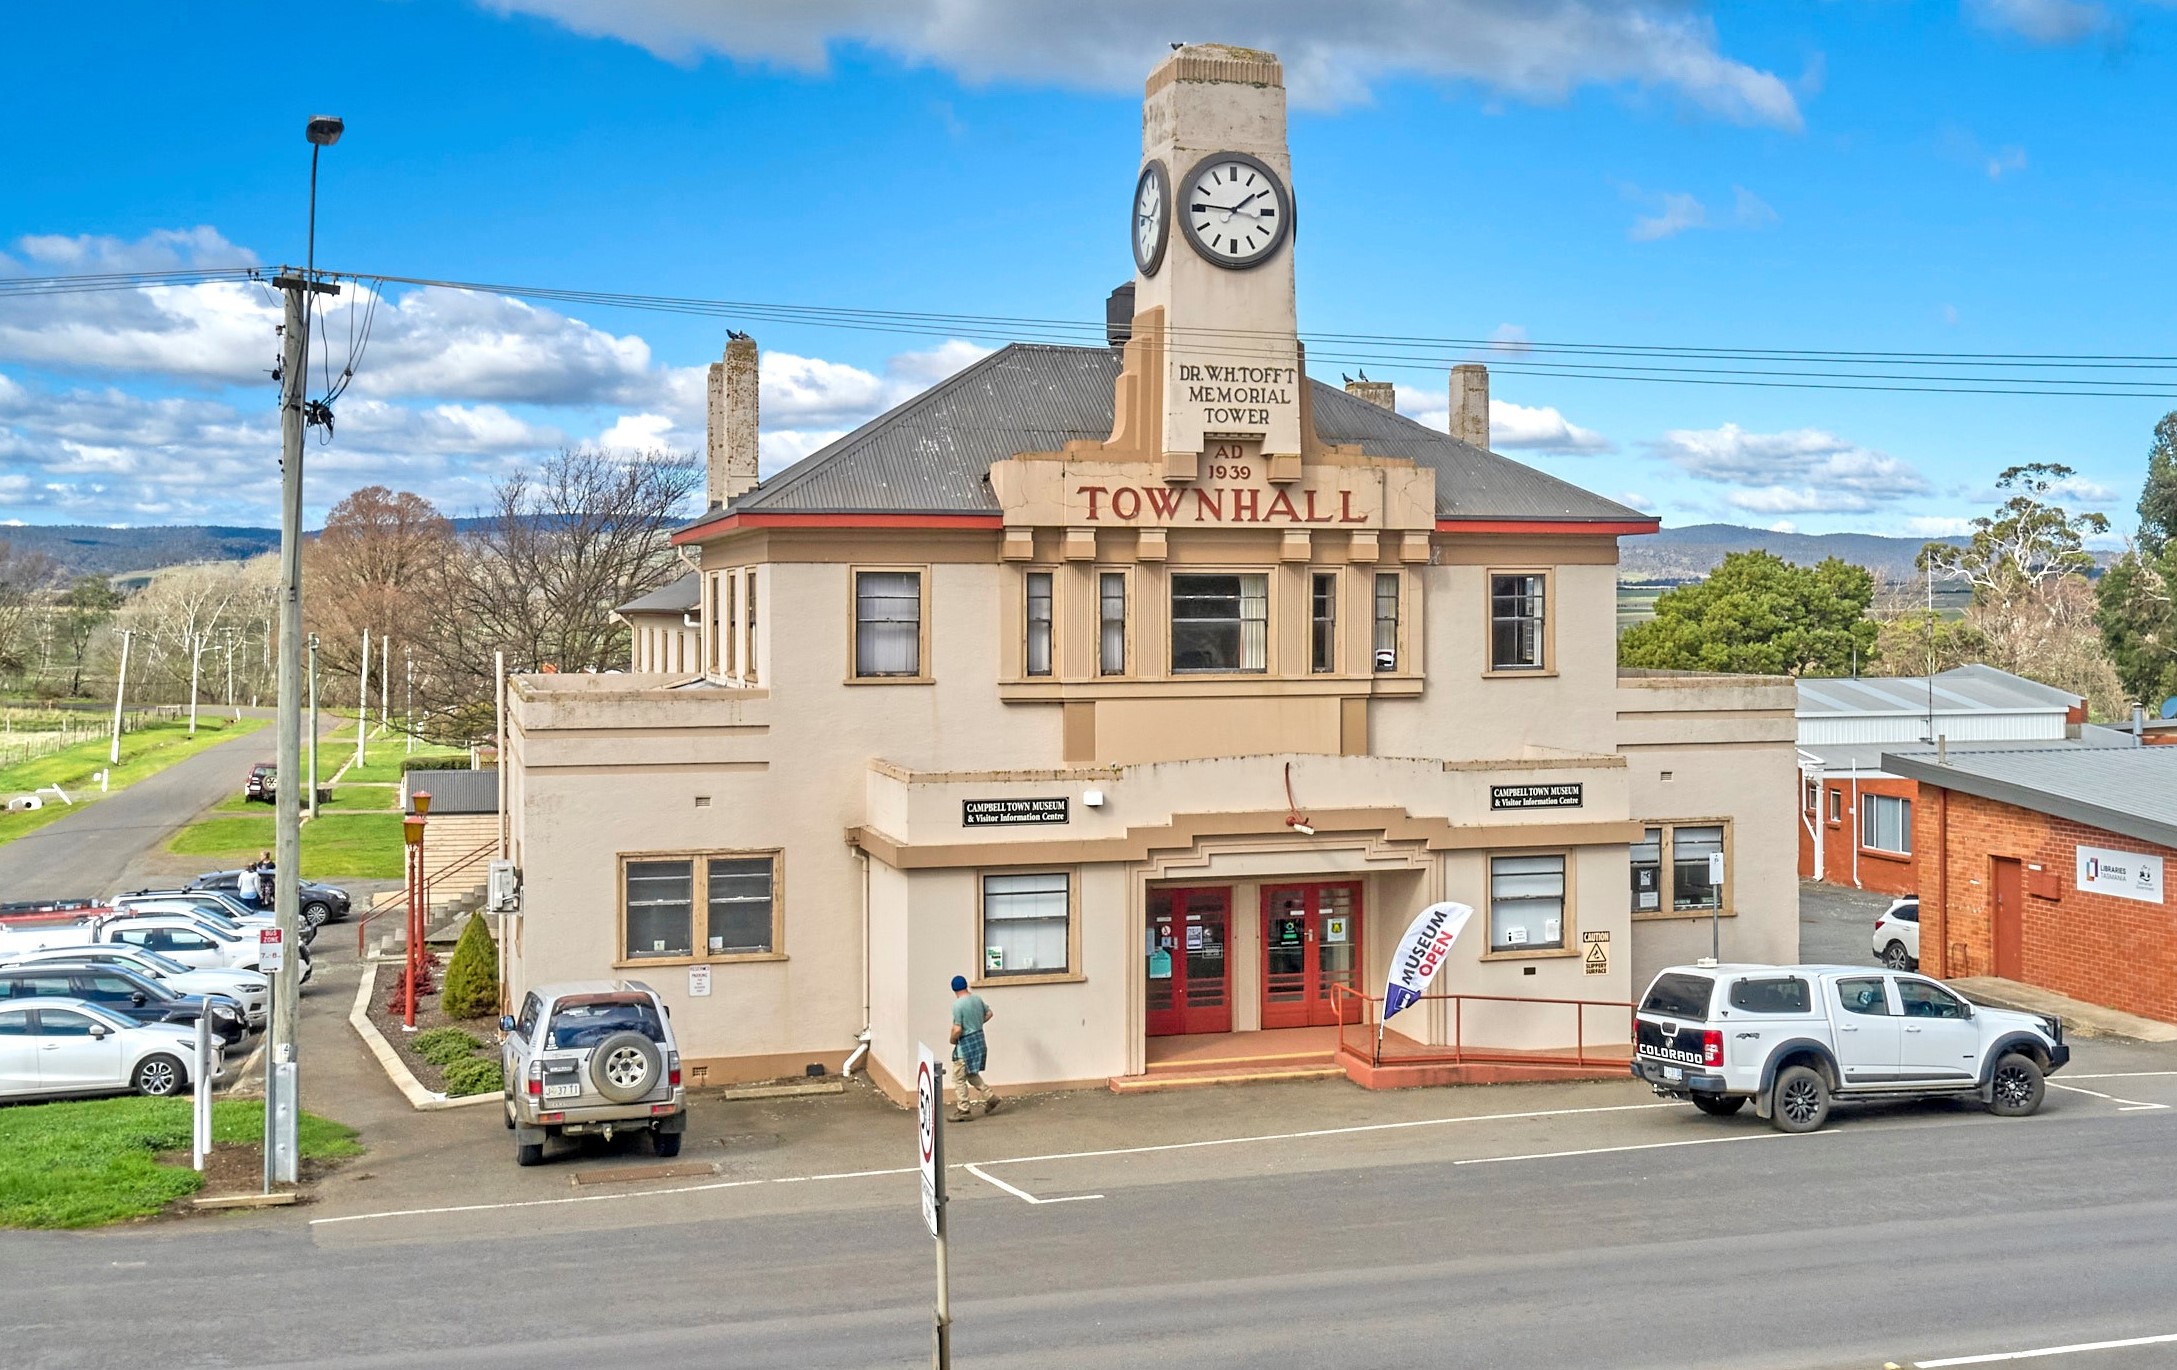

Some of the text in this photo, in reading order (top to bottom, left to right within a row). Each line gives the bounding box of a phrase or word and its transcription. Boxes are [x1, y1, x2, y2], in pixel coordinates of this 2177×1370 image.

[1238, 367, 1297, 384] TOFFT
[1189, 386, 1291, 404] MEMORIAL
[1204, 408, 1269, 424] TOWER
[1215, 445, 1243, 459] AD
[1209, 465, 1251, 479] 1939
[1494, 786, 1579, 797] CAMPBELL TOWN MUSEUM
[966, 800, 1065, 812] CAMPBELL TOWN MUSEUM
[1502, 798, 1522, 806] Visitor
[1522, 797, 1558, 806] Information
[1559, 796, 1578, 804] Centre
[968, 812, 1064, 822] & Visitor Information Centre
[2100, 865, 2126, 874] LIBRARIES
[2100, 872, 2127, 882] TASMANIA
[1584, 932, 1609, 942] CAUTION
[1402, 910, 1448, 985] MUSEUM
[1419, 930, 1453, 976] OPEN
[1640, 1044, 1702, 1064] COLORADO
